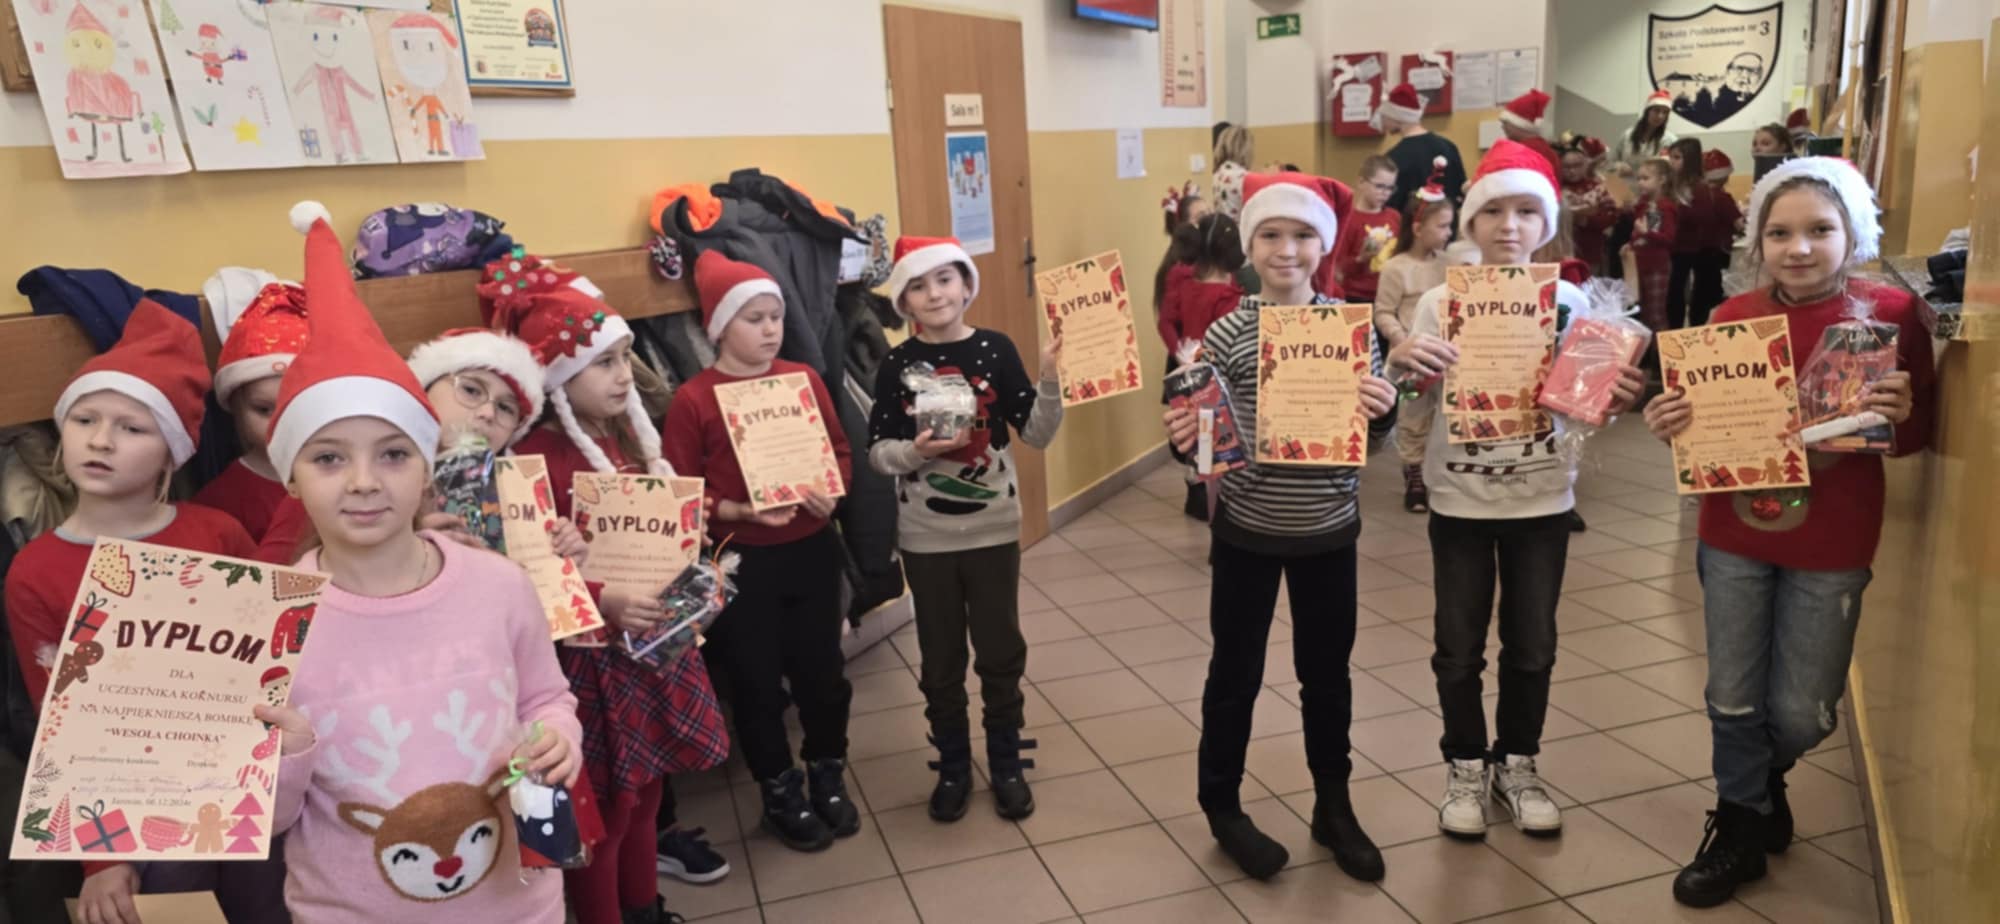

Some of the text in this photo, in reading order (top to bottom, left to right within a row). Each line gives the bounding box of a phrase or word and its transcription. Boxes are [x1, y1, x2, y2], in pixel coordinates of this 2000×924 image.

[1759, 20, 1770, 36] 3
[1060, 290, 1112, 316] DYPLOM
[1467, 301, 1537, 318] DYPLOM
[1280, 343, 1349, 362] DYPLOM
[1686, 362, 1767, 386] DYPLOM
[743, 405, 802, 425] DYPLOM
[597, 515, 677, 538] DYPLOM
[116, 620, 266, 664] DYPLOM
[169, 668, 195, 680] DLA
[98, 684, 177, 699] UCZESTNIKA
[79, 703, 98, 714] NA
